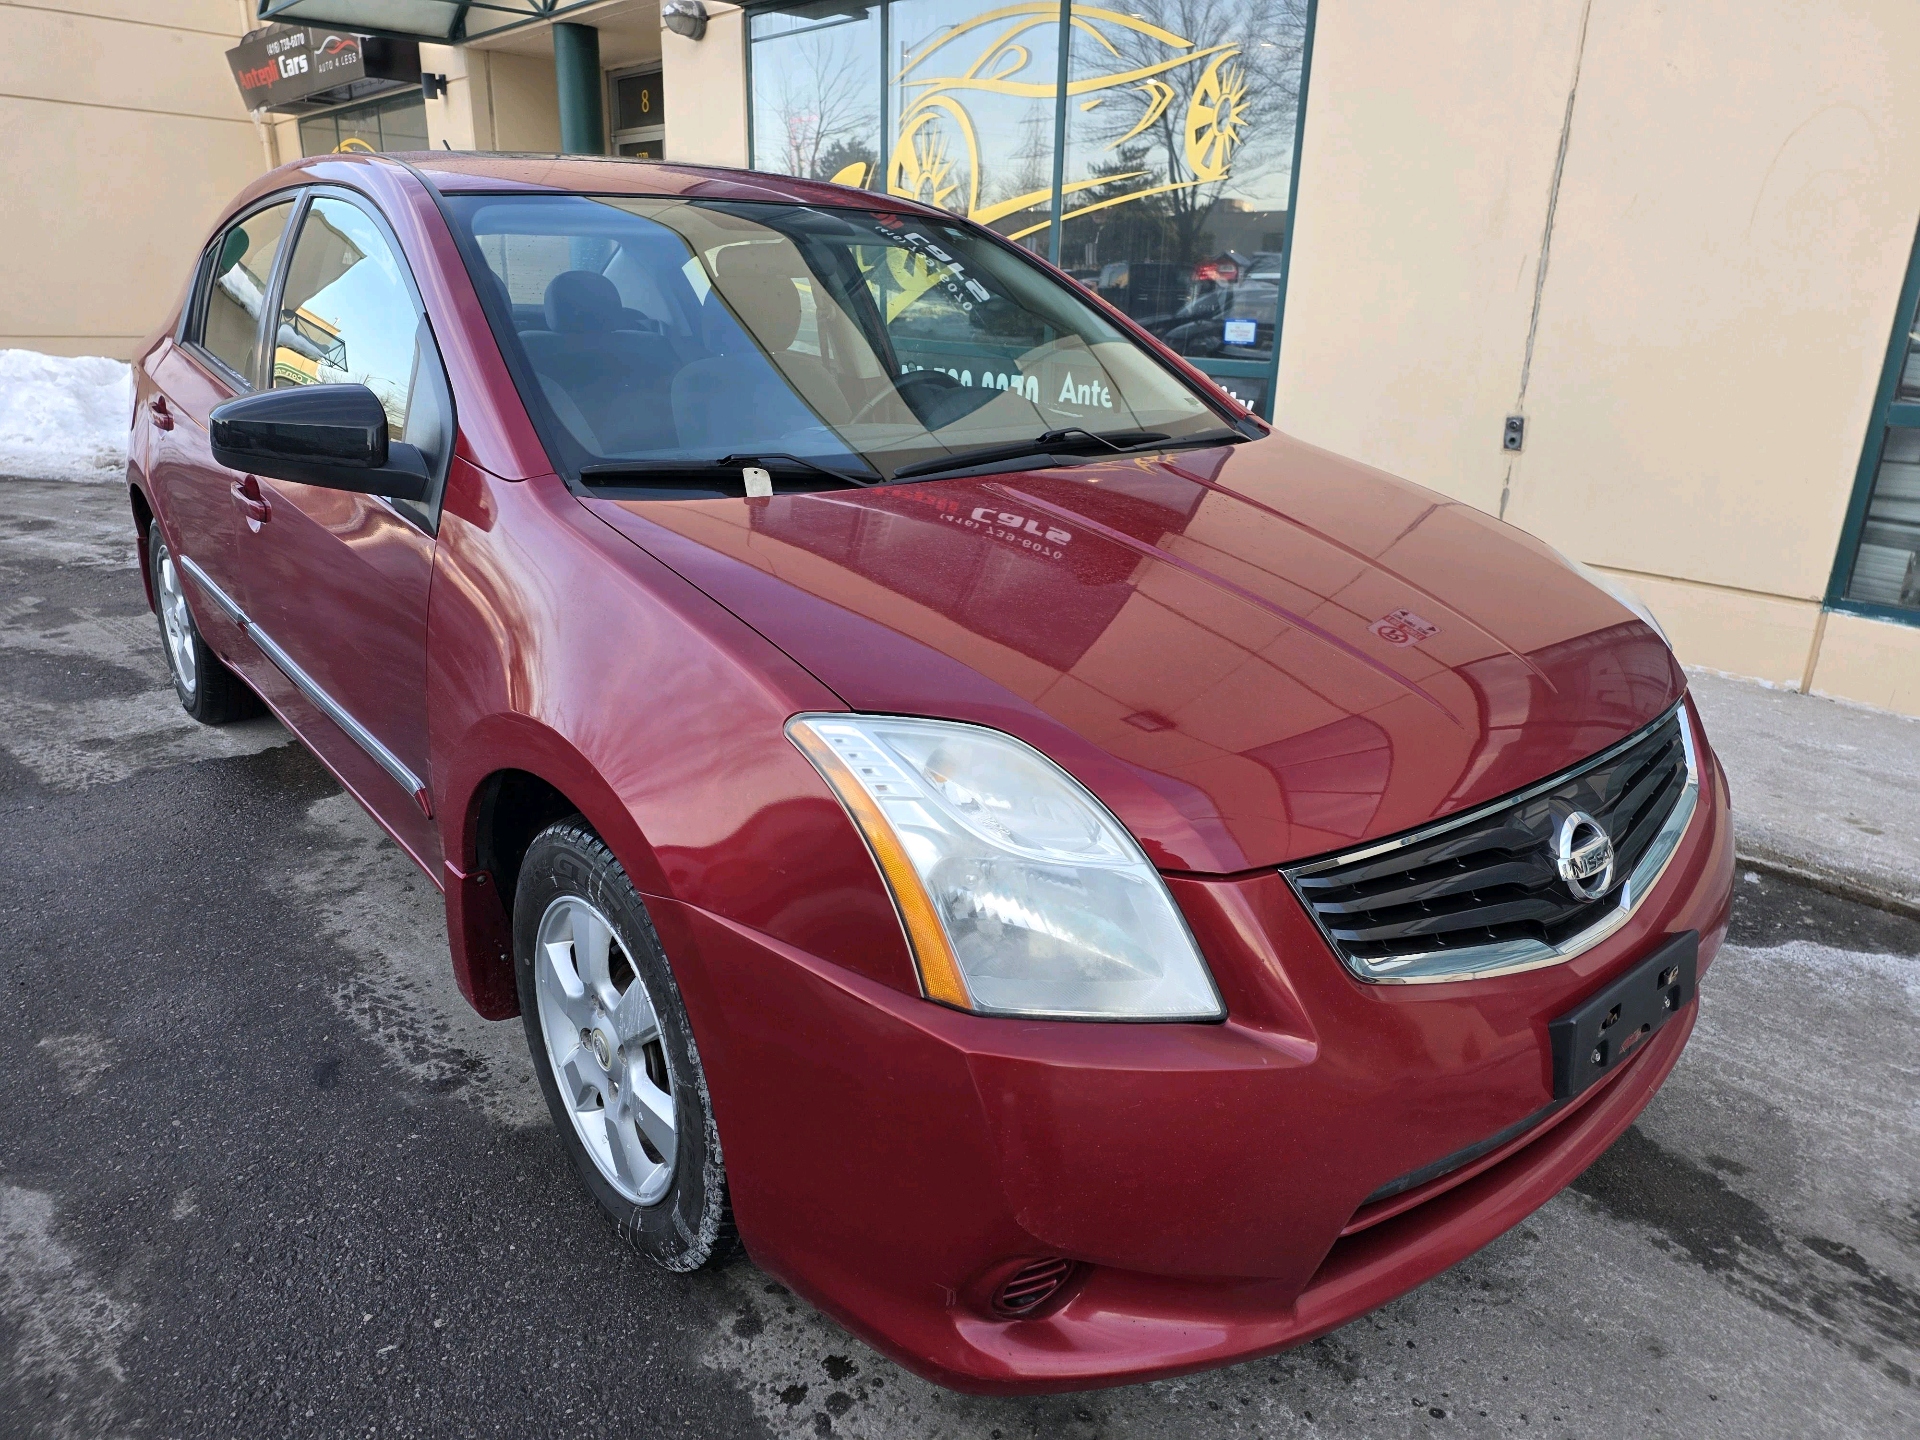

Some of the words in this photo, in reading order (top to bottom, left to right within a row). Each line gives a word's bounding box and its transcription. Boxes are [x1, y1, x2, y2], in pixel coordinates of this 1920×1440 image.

[238, 59, 280, 90] Antepli
[278, 53, 308, 79] Cars
[318, 60, 333, 73] AUTO
[340, 52, 357, 66] LESS
[641, 90, 649, 113] 8
